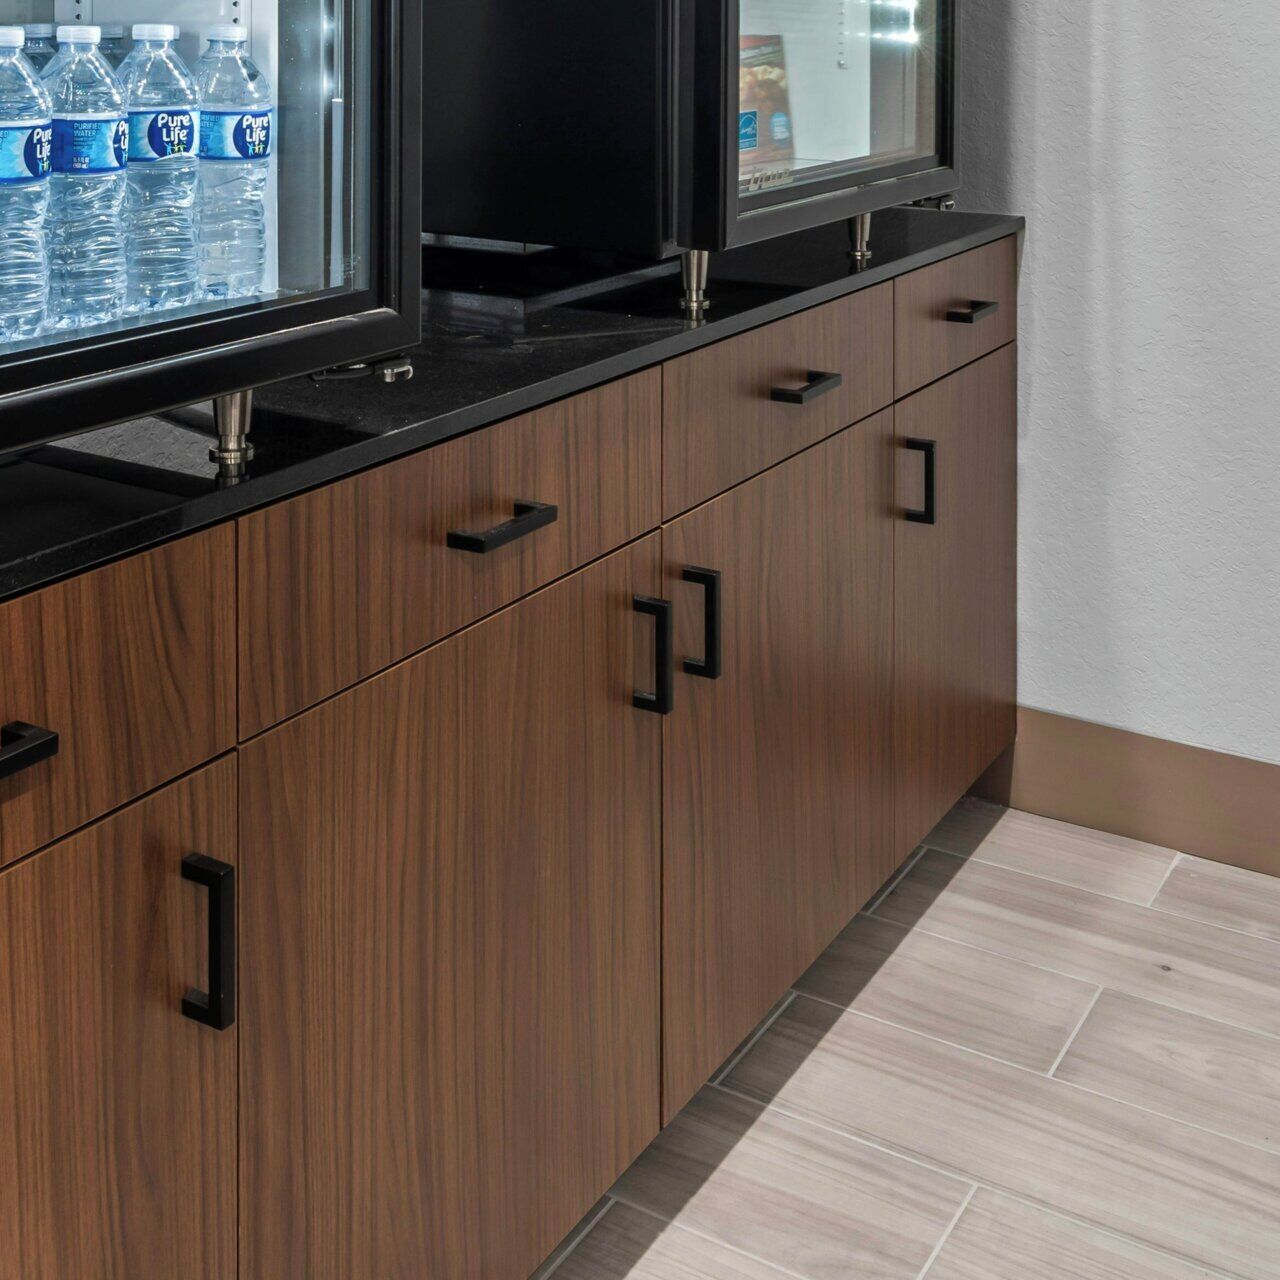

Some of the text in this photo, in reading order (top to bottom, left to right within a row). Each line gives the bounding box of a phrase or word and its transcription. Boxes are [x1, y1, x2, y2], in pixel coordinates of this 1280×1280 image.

[158, 113, 190, 128] Pure
[242, 115, 269, 128] Pure
[162, 127, 188, 143] Life
[246, 128, 266, 145] Life
